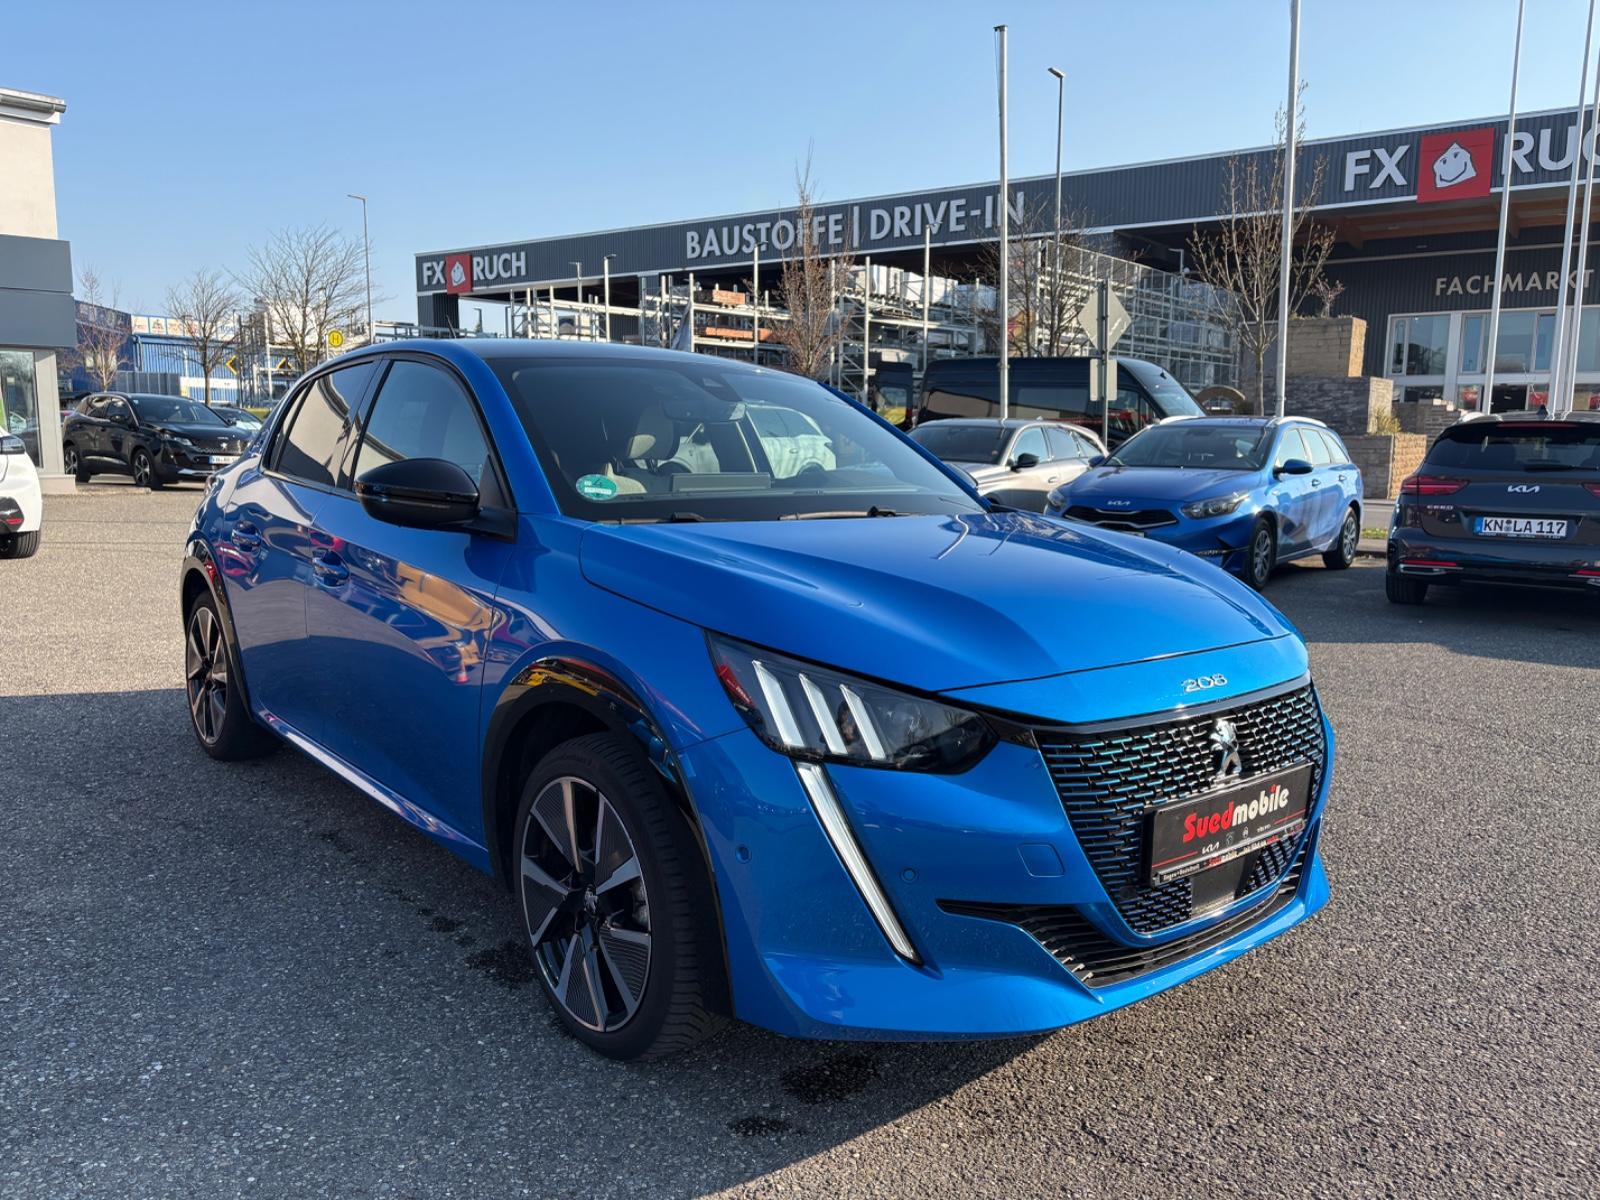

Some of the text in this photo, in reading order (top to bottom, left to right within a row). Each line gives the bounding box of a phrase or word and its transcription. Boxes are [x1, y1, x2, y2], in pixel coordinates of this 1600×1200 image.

[1344, 144, 1411, 193] FX
[870, 191, 1025, 242] DRIVE-IN
[422, 251, 527, 286] FX RUCH
[332, 333, 340, 345] H
[1483, 519, 1567, 535] KN LA 117
[1181, 673, 1228, 692] 208
[1183, 783, 1290, 844] Suedmobile
